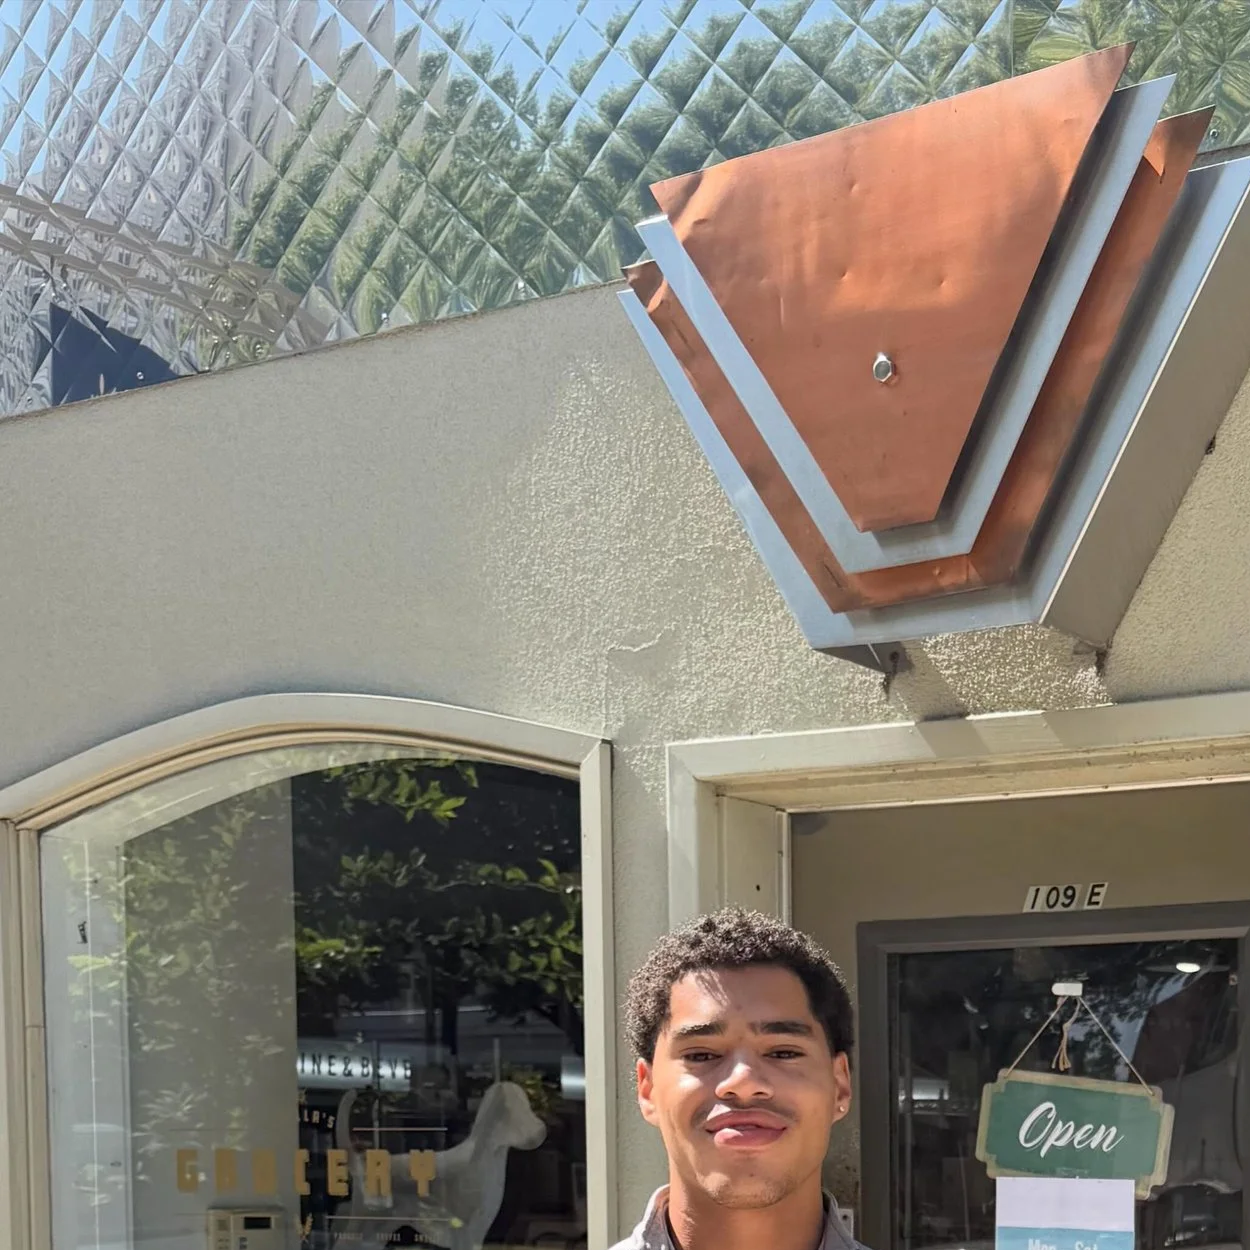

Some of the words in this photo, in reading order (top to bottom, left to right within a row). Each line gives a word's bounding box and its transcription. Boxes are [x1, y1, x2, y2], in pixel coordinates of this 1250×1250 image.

[1030, 885, 1076, 910] 109
[1087, 884, 1105, 906] E
[1018, 1101, 1124, 1158] Open
